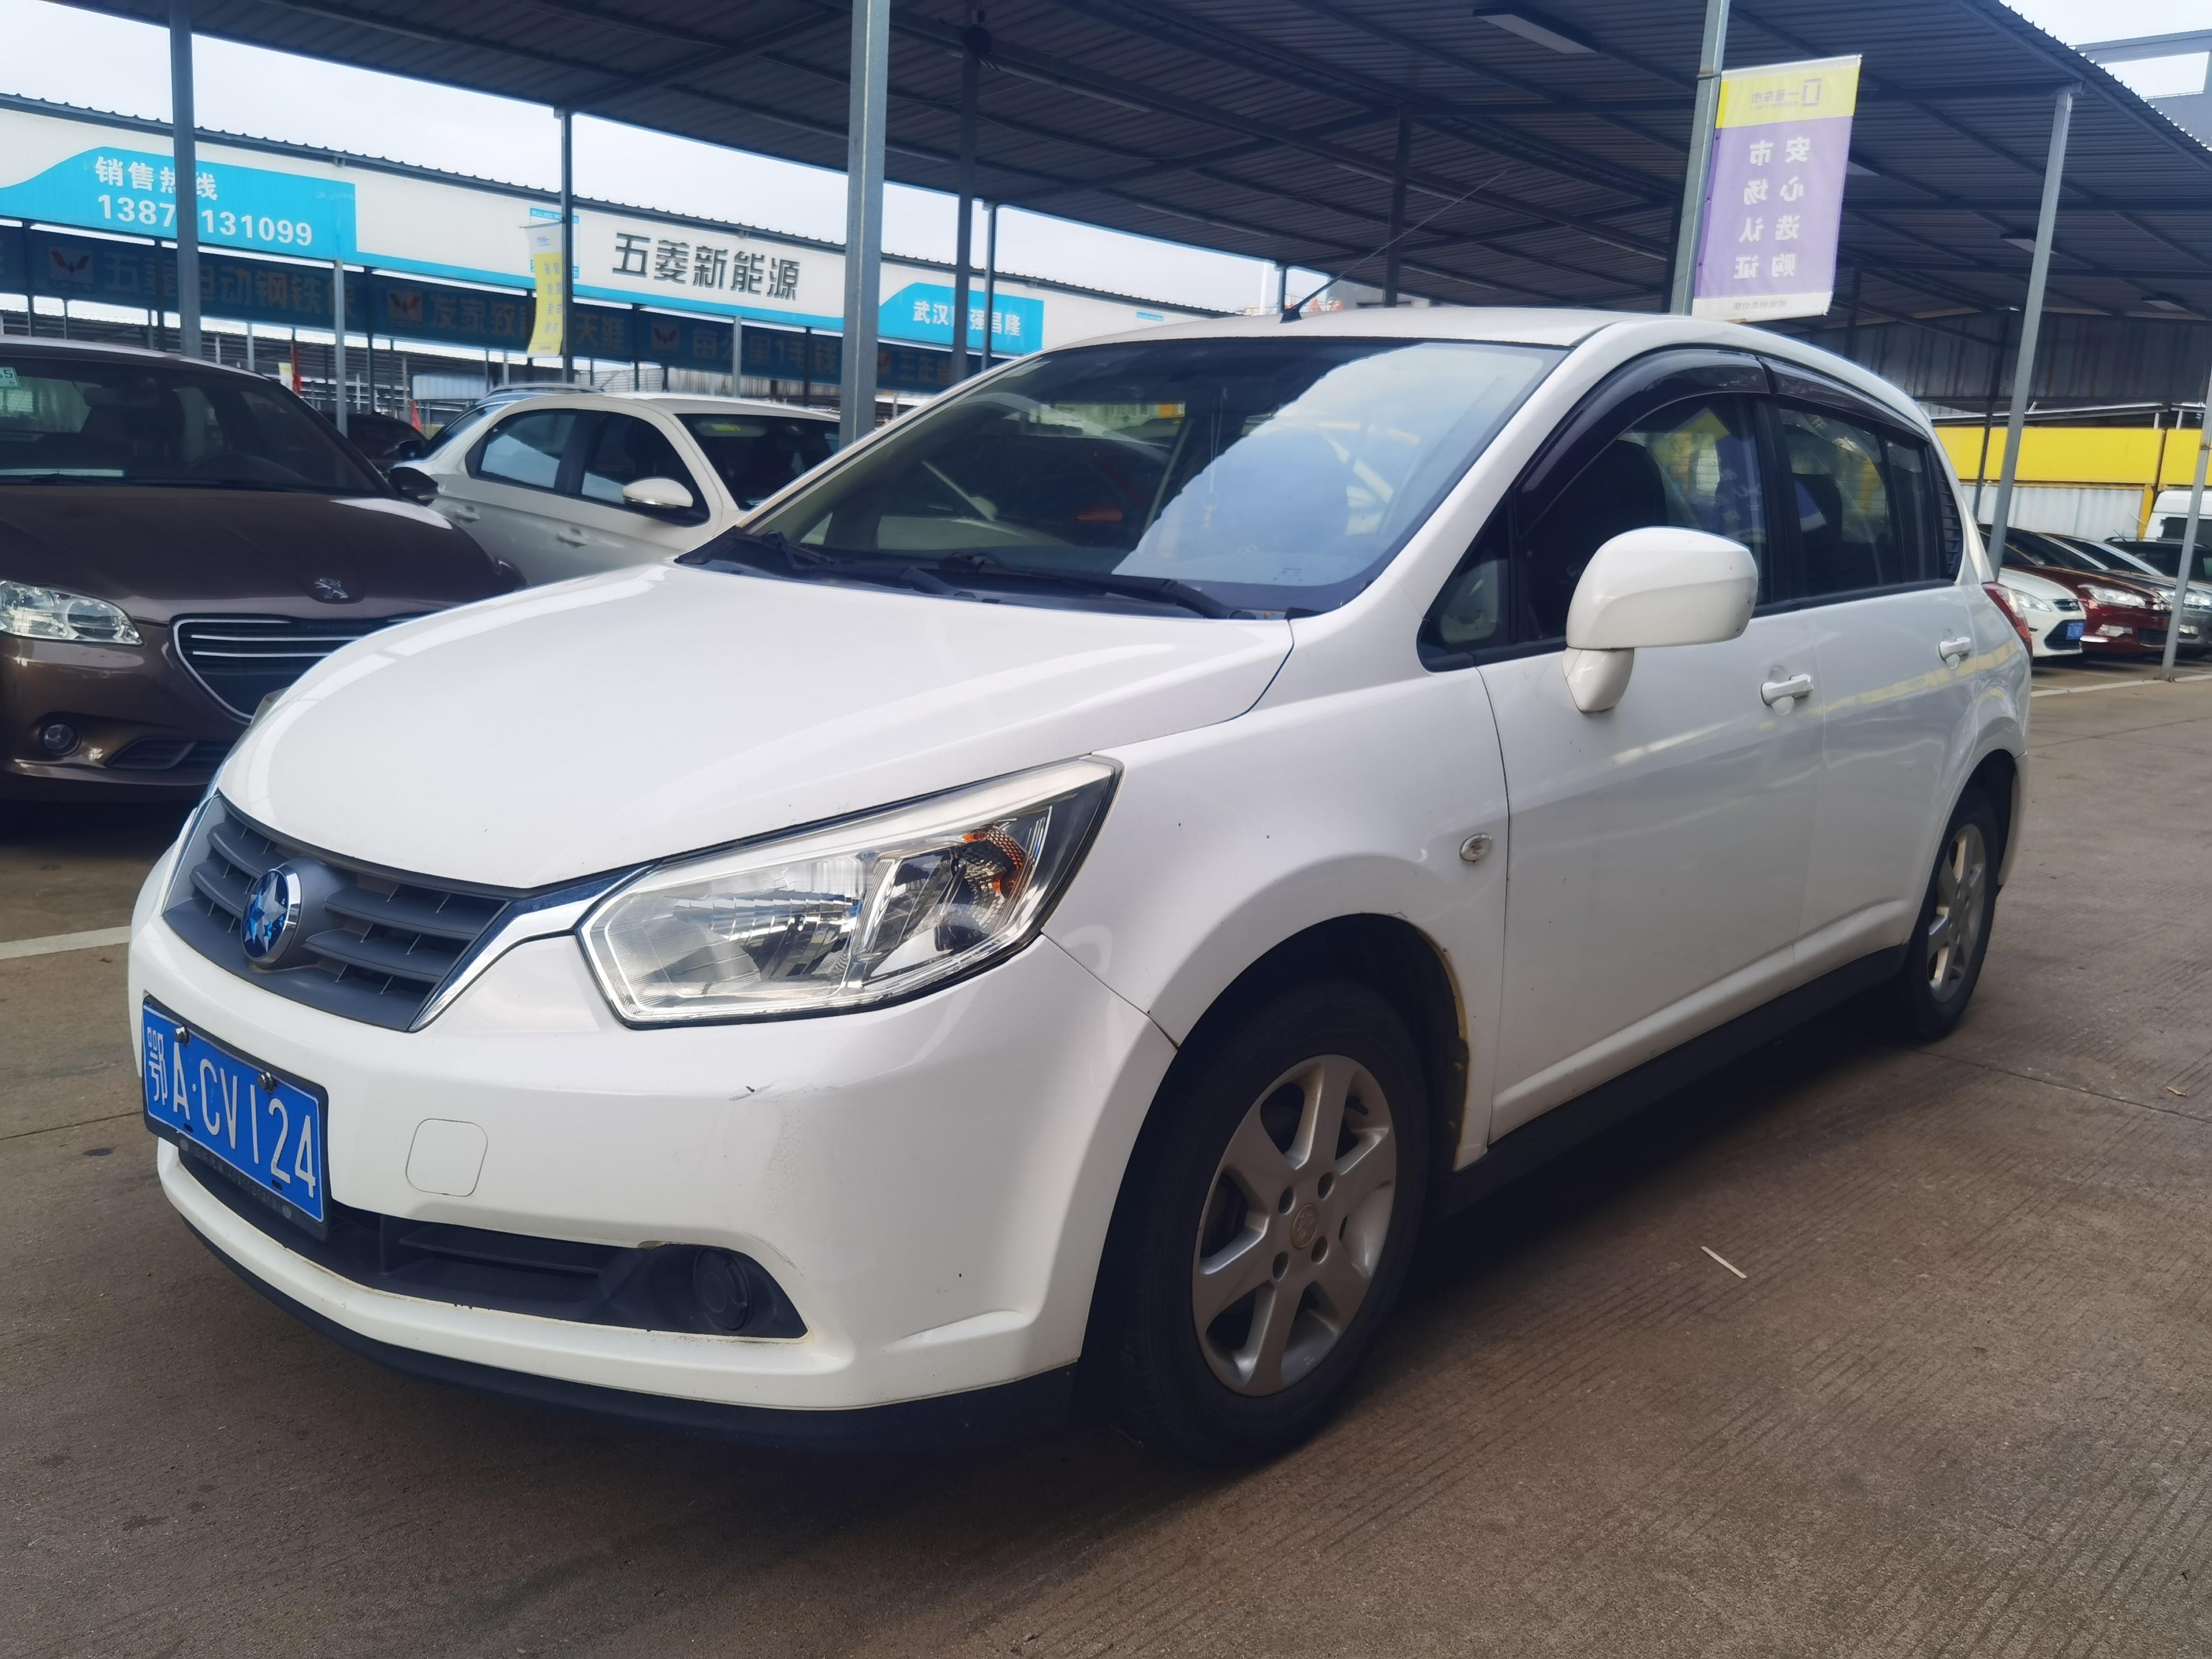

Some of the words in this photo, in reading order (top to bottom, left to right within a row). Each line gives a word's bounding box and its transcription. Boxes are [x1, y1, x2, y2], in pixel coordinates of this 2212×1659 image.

[95, 156, 218, 200] 销售热线
[98, 194, 313, 246] 1387131099
[612, 232, 801, 301] 五菱新能源
[913, 301, 1021, 336] 武汉强昌隆
[0, 369, 14, 378] 5
